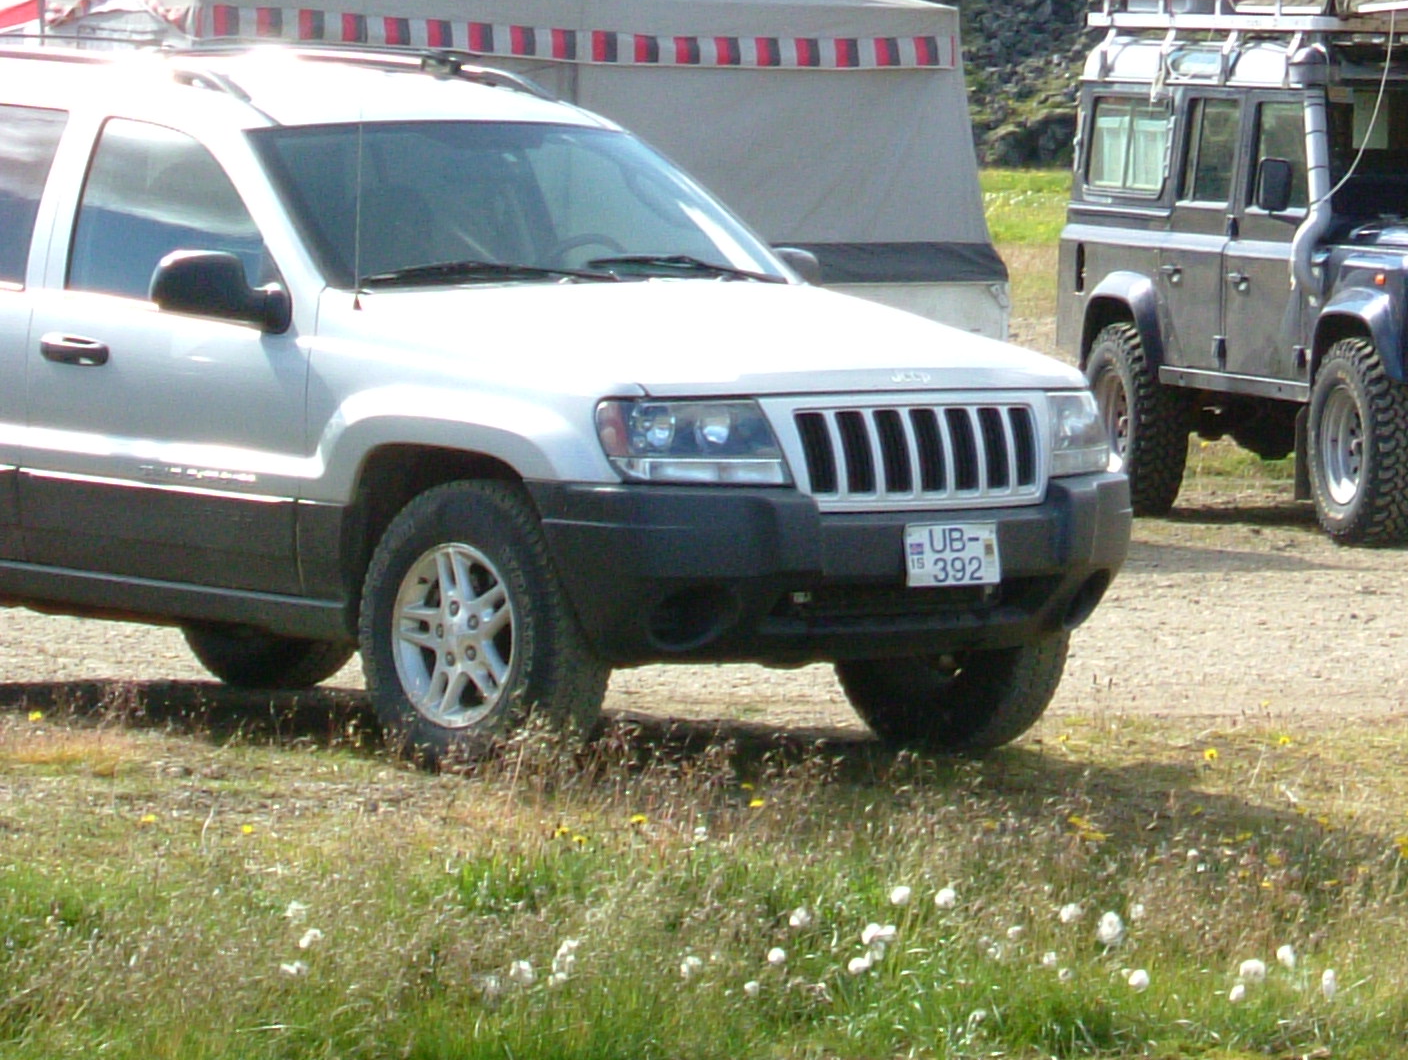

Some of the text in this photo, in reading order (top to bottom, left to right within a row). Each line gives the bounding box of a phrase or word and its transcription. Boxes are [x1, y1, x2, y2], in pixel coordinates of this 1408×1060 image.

[891, 369, 931, 385] Jeep
[928, 527, 980, 553] UB-
[933, 556, 983, 583] 392
